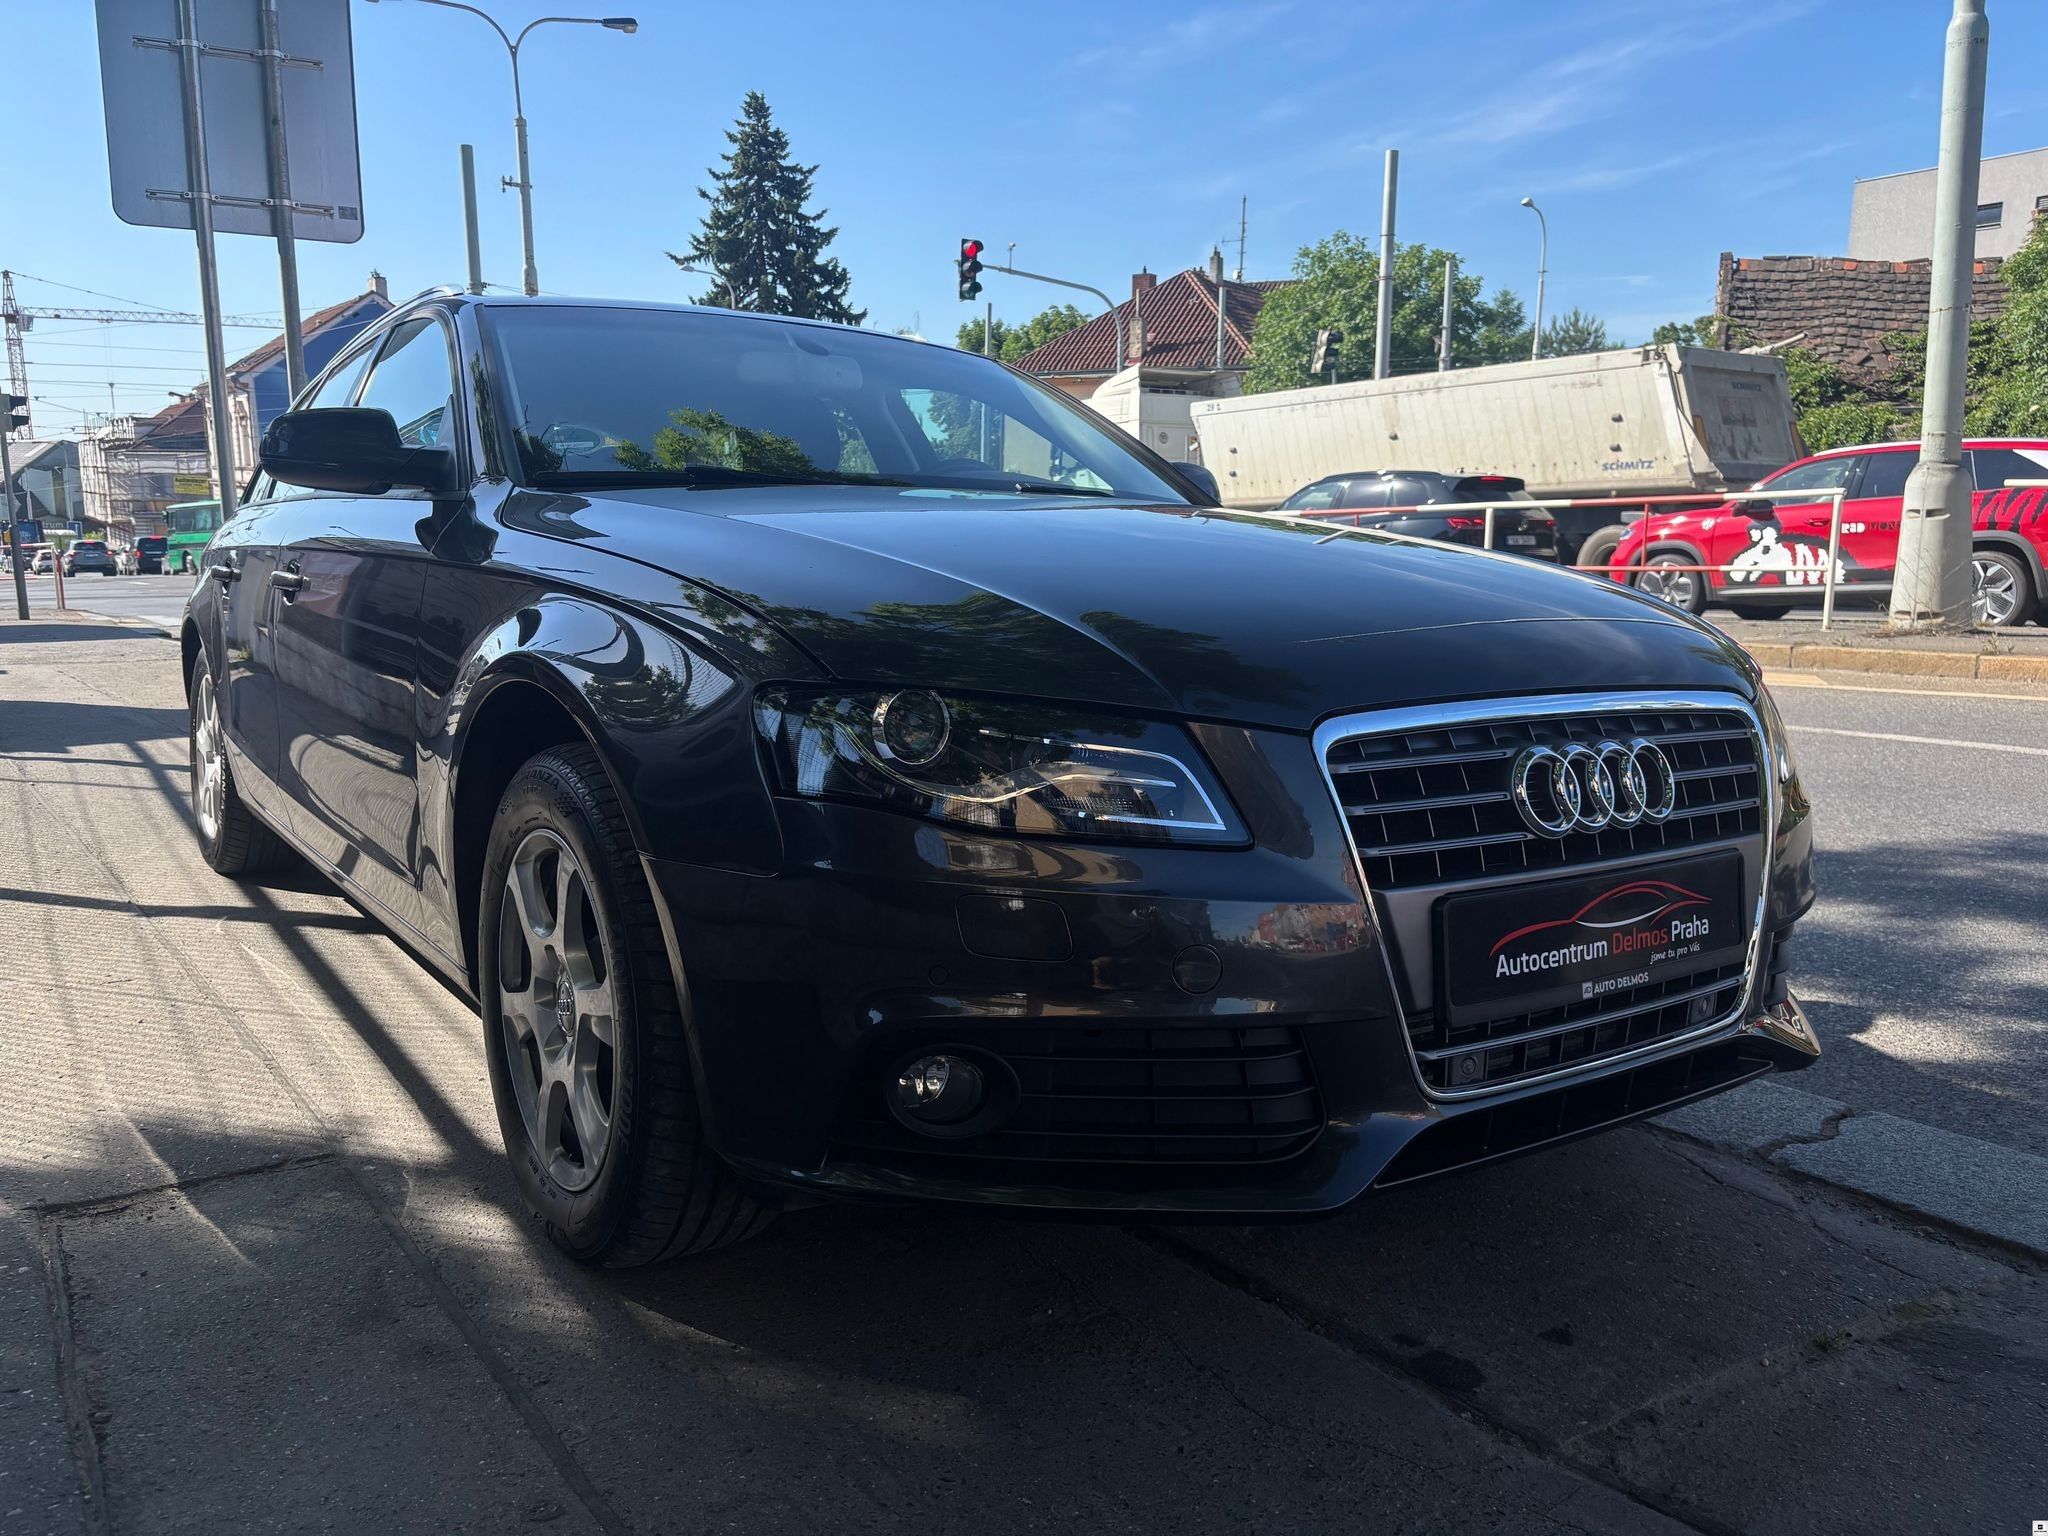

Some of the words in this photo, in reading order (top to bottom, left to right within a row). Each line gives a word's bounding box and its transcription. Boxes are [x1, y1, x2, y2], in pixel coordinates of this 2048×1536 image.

[1602, 460, 1655, 471] SCHMITZ
[1495, 940, 1608, 978] Autocentrum
[1612, 927, 1668, 955] Delmos
[1671, 914, 1709, 942] Praha
[1649, 951, 1666, 965] jsme
[1667, 948, 1676, 958] tu
[1676, 946, 1688, 959] pro
[1593, 979, 1616, 994] AUTO
[1617, 972, 1649, 989] DELMOS
